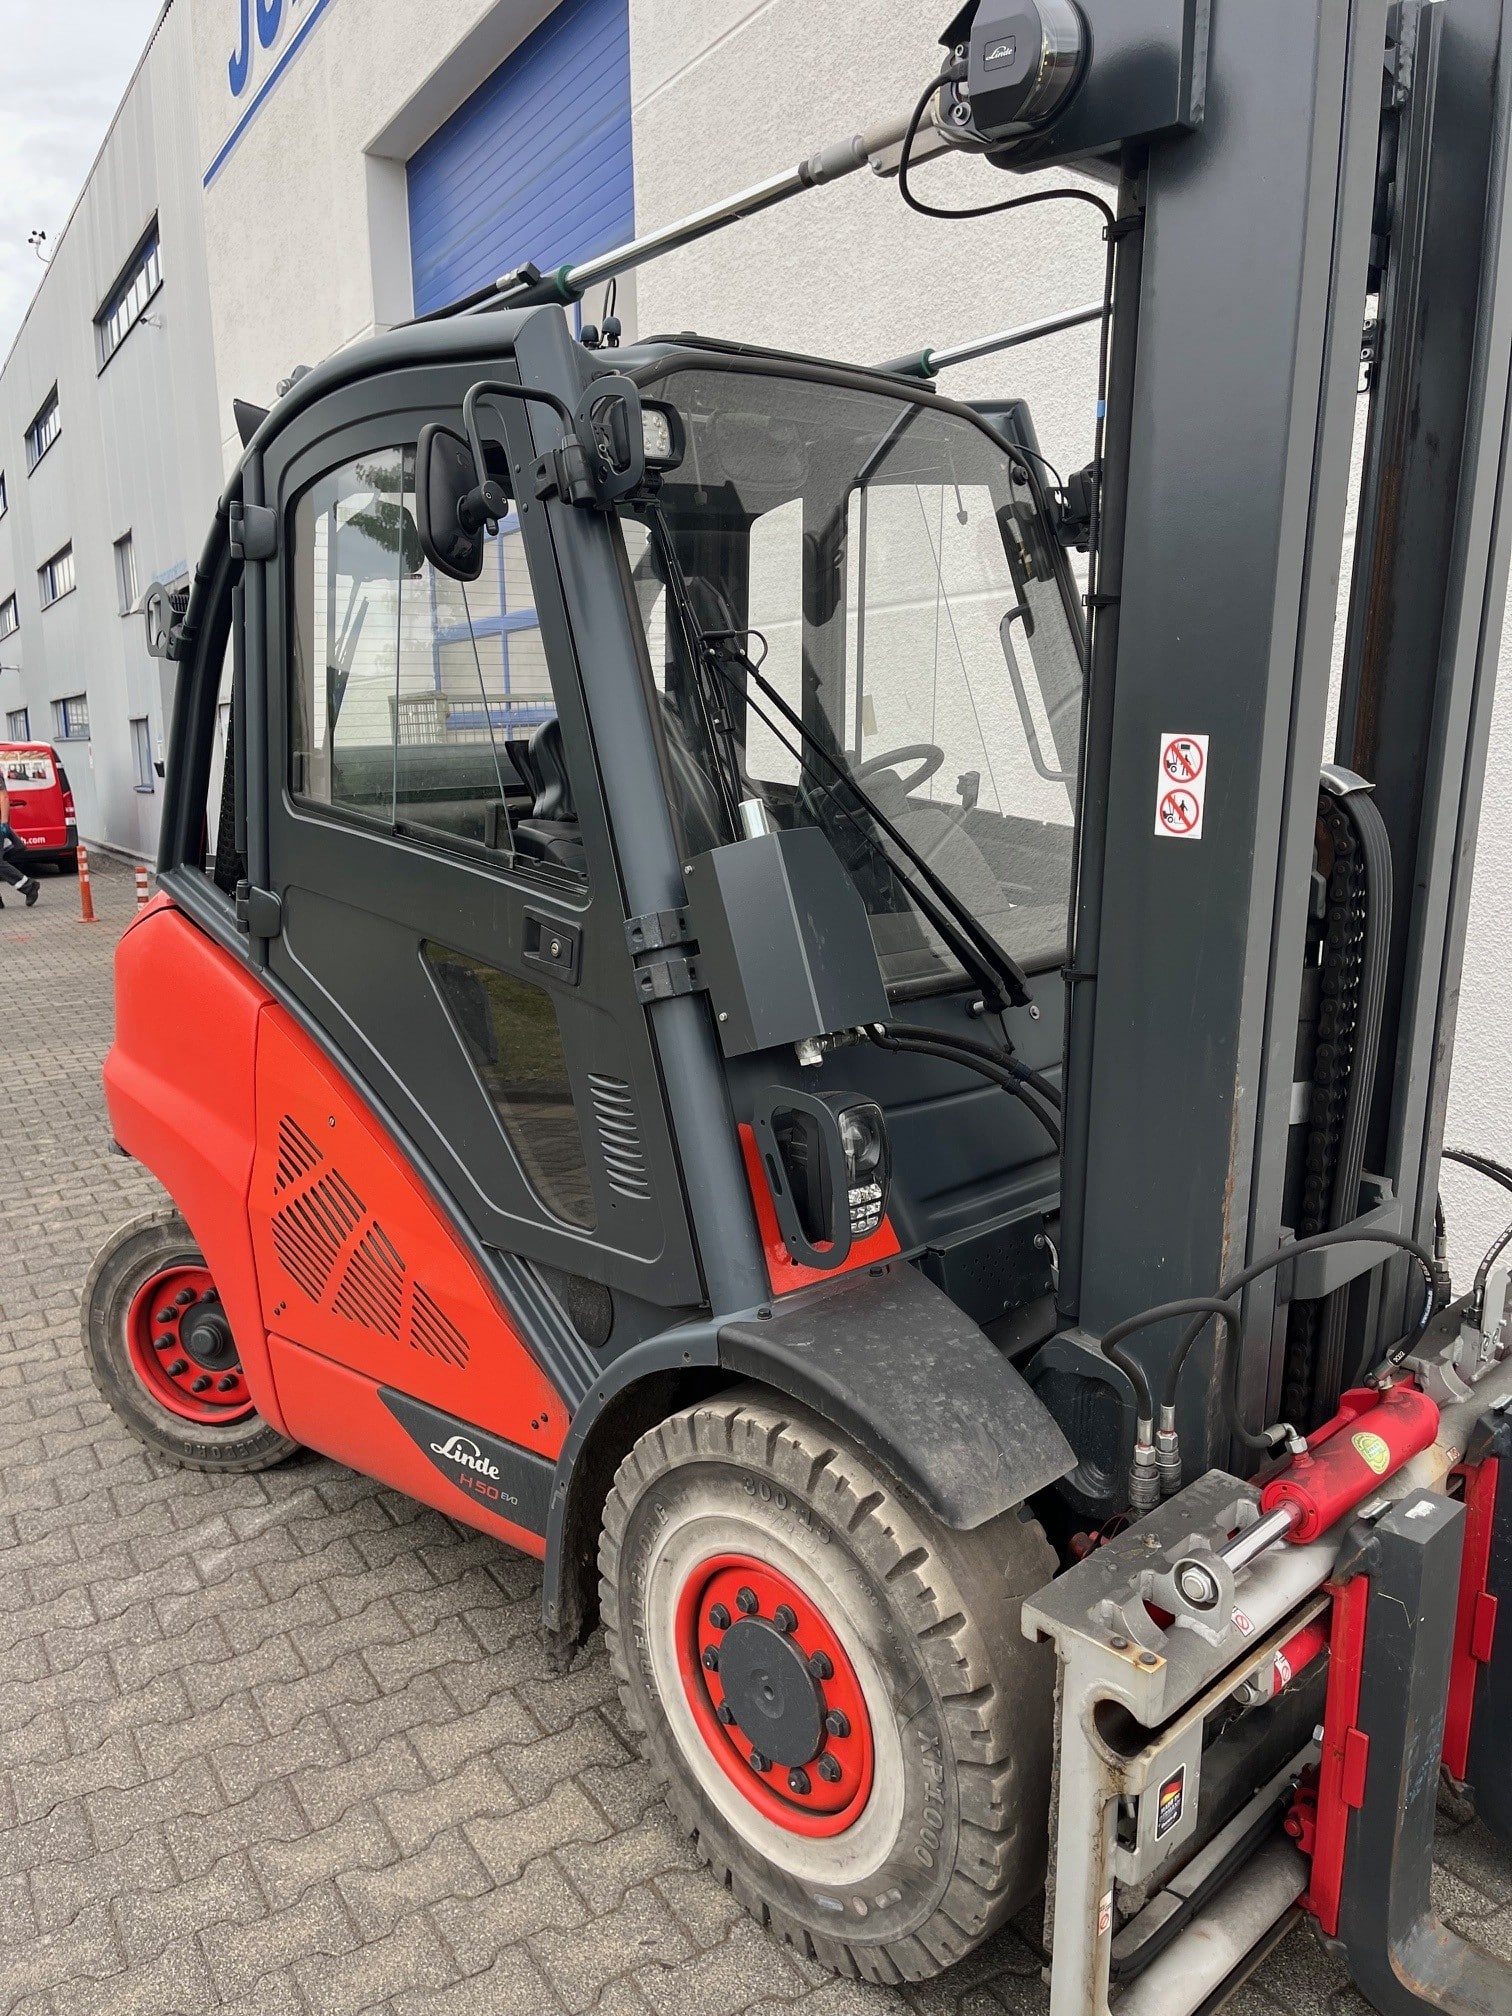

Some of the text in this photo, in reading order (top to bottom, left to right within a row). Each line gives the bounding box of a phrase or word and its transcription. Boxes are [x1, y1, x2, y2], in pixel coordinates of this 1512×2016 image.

[985, 45, 1013, 61] Linde
[430, 1435, 501, 1480] Linde
[630, 1502, 670, 1701] TRELLEBORG
[914, 1730, 946, 1868] XP1000
